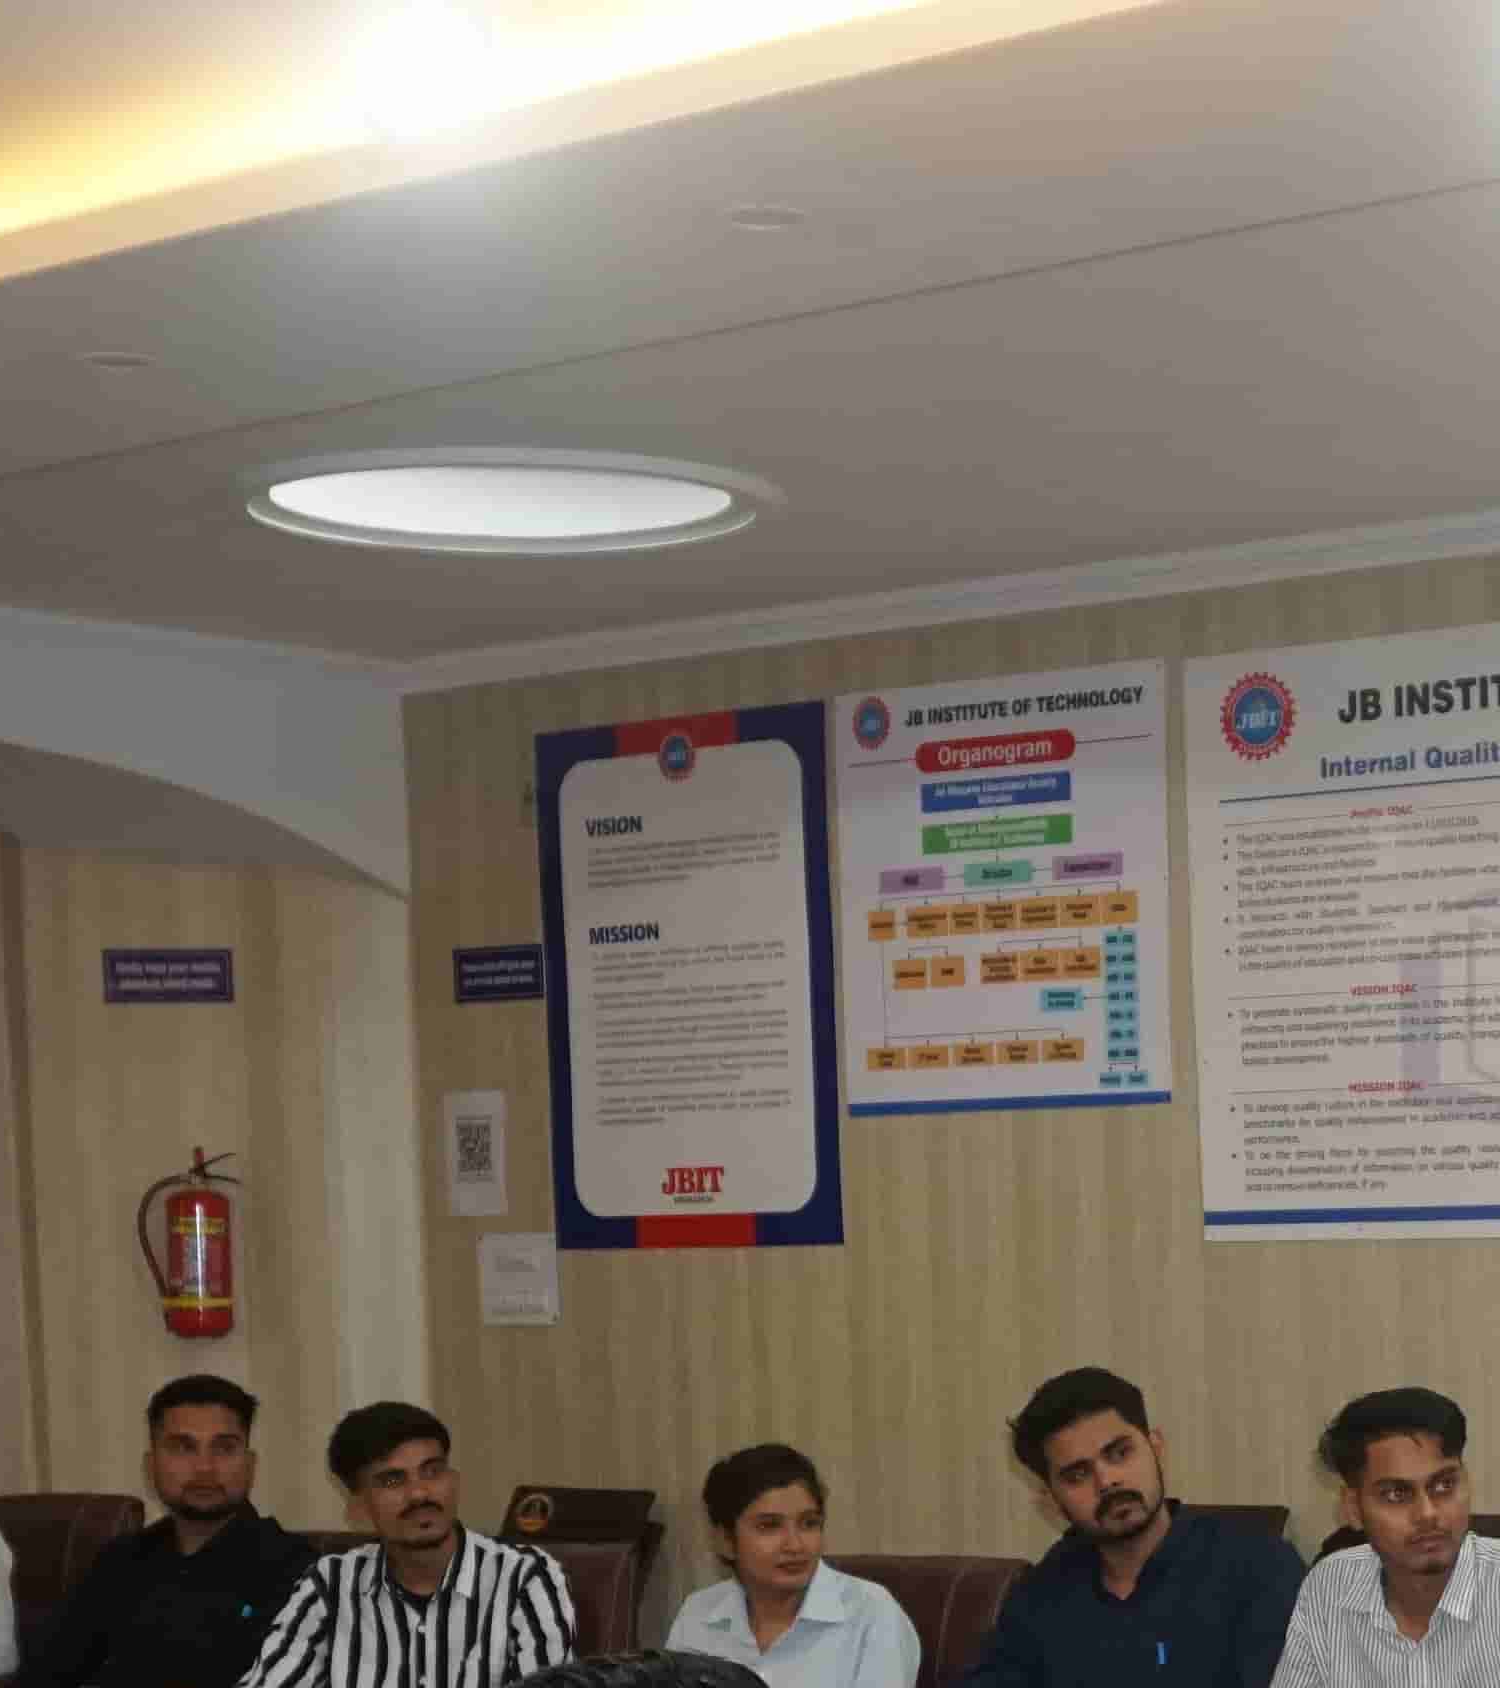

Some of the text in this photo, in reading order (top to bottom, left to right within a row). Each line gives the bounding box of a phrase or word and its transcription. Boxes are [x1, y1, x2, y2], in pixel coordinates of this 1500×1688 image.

[905, 707, 923, 727] JB
[928, 700, 1008, 725] INSTITUTE
[1012, 698, 1031, 716] OF
[1036, 686, 1143, 713] TECHNOLOGY
[1338, 688, 1382, 723] JB
[937, 739, 1052, 768] Organogram
[1320, 752, 1415, 778] Internal
[586, 815, 642, 837] VISION
[589, 923, 660, 944] MISSION
[662, 1166, 724, 1195] JBIT
